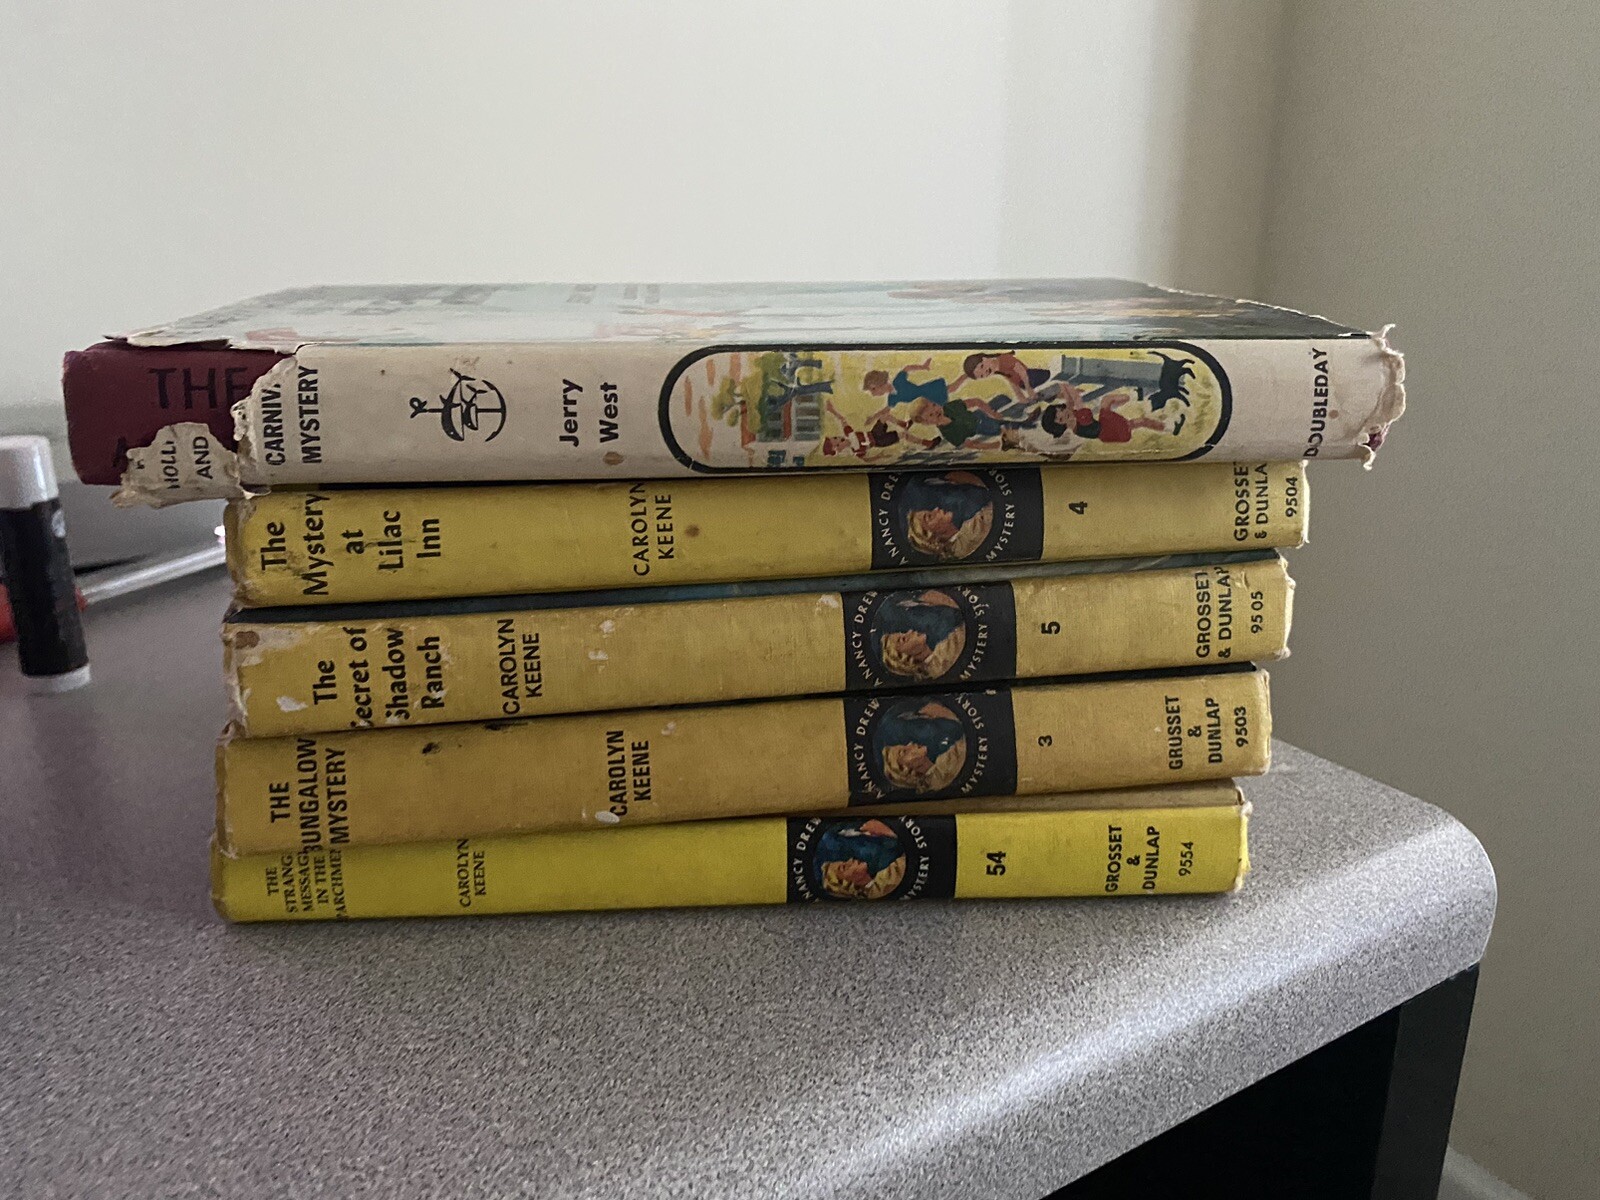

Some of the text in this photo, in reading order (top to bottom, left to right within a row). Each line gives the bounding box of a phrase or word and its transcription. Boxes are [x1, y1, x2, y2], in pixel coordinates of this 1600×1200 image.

[261, 383, 286, 467] CARNIV
[298, 364, 323, 464] MYSTERY
[559, 378, 584, 448] Jerry
[599, 381, 619, 444] West
[1303, 347, 1330, 459] DOUBLEDAY
[192, 436, 213, 480] AND
[881, 471, 900, 501] DRE
[1069, 501, 1088, 515] 4
[1233, 461, 1250, 541] GROSSE
[1254, 463, 1269, 525] DUNLA
[1285, 476, 1298, 518] 9504
[260, 521, 288, 571] The
[301, 493, 335, 596] Mystery
[342, 529, 365, 554] at
[377, 509, 404, 573] Lilac
[416, 517, 442, 559] Inn
[629, 482, 650, 577] CAROLYN
[655, 494, 675, 560] KEENE
[878, 508, 900, 558] NANCY
[985, 503, 1016, 562] MYSTERY
[343, 626, 368, 652] of
[959, 623, 988, 681] MYSTERY
[1041, 621, 1061, 635] 5
[1218, 647, 1231, 659] &
[417, 636, 445, 710] Ranch
[497, 618, 521, 715] CAROLYN
[522, 632, 543, 699] KEENE
[852, 631, 873, 680] NANCY
[312, 659, 338, 705] The
[856, 698, 880, 736] DREW
[1038, 735, 1053, 747] 3
[1187, 725, 1202, 738] &
[1205, 697, 1223, 764] DUNLAP
[1234, 706, 1248, 748] 9503
[607, 731, 628, 817] CAROLYN
[632, 741, 651, 801] KEENE
[854, 743, 880, 795] NANCY
[961, 736, 988, 794] MYSTERY
[269, 781, 291, 823] THE
[325, 747, 350, 845] MYSTERY
[265, 867, 279, 896] THE
[313, 855, 329, 905] IN THE
[456, 838, 471, 907] CAROLYN
[473, 851, 486, 896] KEENE
[985, 851, 1007, 876] 54
[1105, 825, 1122, 892] GROSSET
[1127, 855, 1140, 866] &
[1142, 826, 1160, 890] DUNLAP
[1179, 841, 1193, 876] 9554
